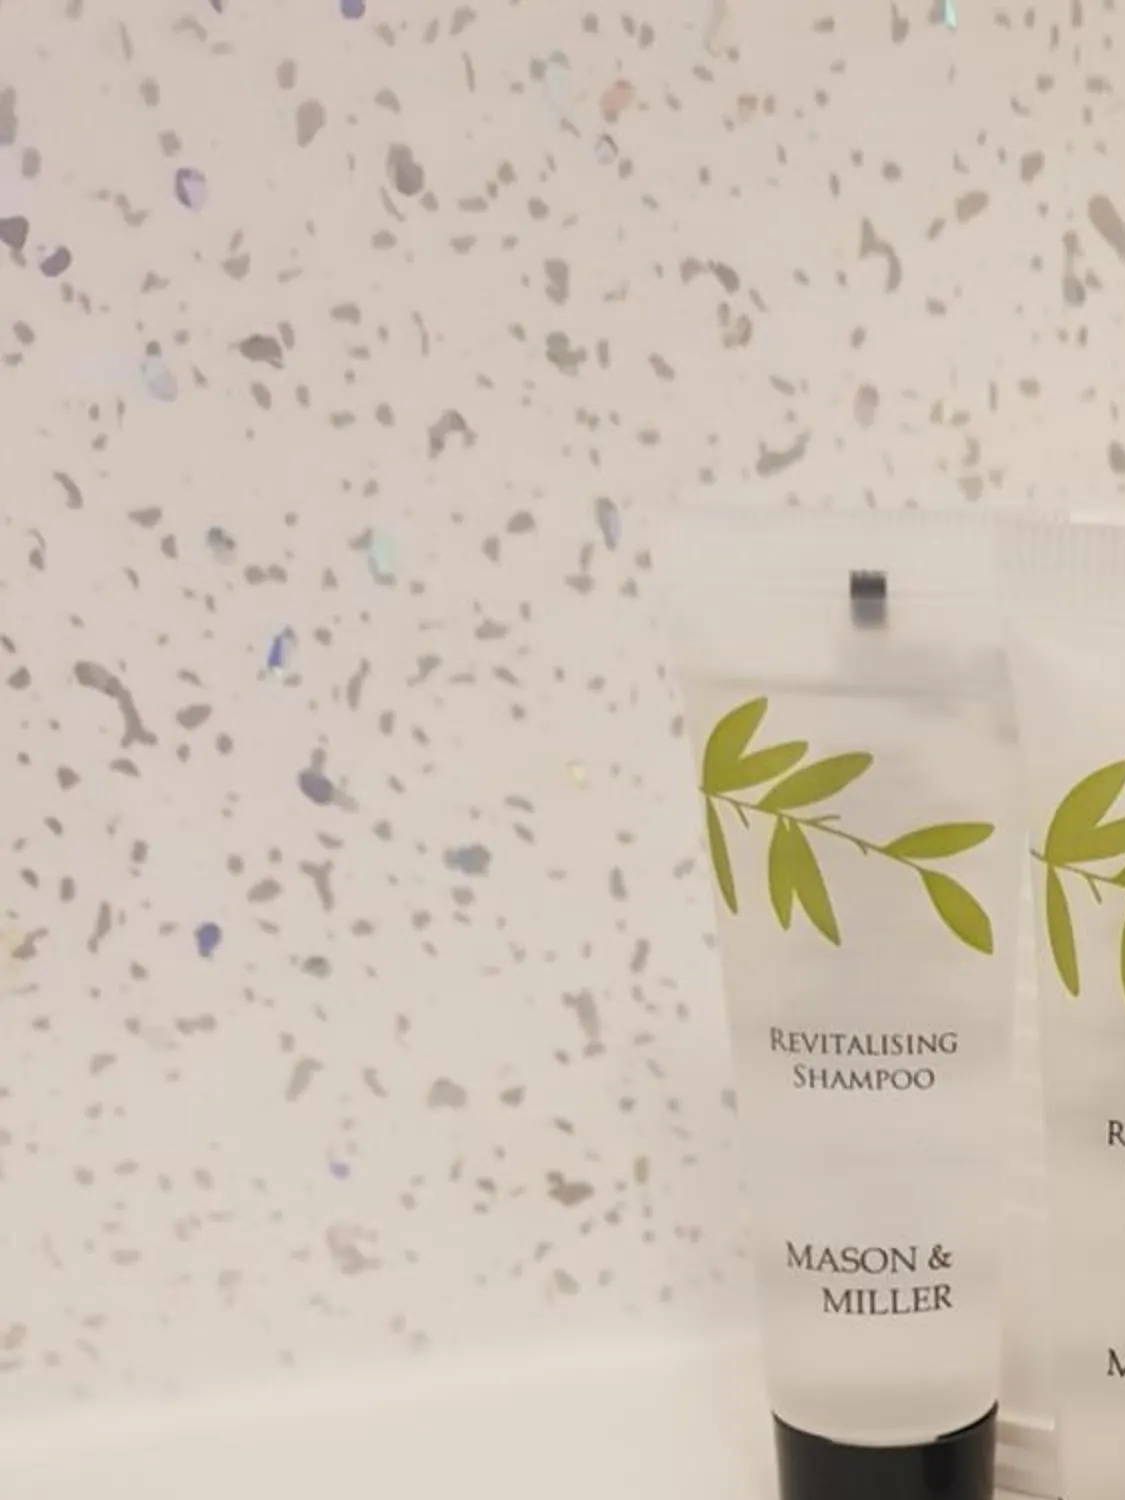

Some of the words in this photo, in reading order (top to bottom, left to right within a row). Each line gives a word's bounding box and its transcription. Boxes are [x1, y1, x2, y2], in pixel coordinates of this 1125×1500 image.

[769, 1026, 958, 1057] REVITALISING
[793, 1063, 935, 1090] SHAMPOO
[786, 1241, 918, 1274] MASON
[927, 1244, 954, 1270] &
[822, 1284, 953, 1316] MILLER
